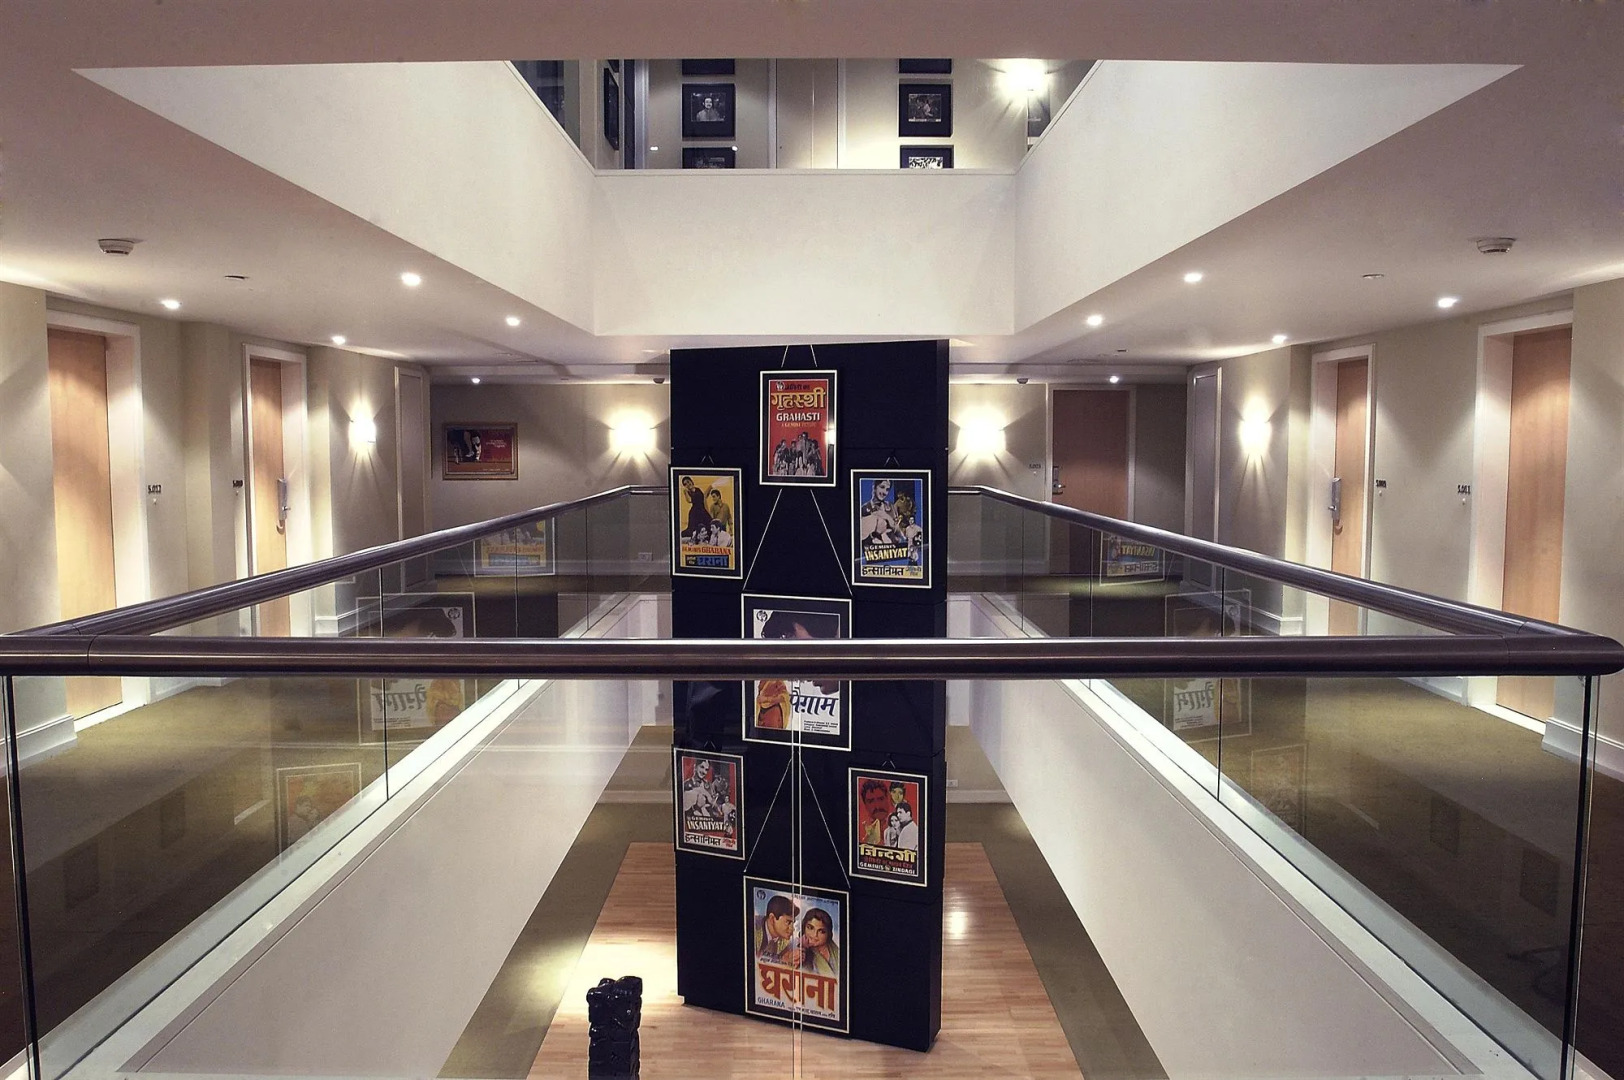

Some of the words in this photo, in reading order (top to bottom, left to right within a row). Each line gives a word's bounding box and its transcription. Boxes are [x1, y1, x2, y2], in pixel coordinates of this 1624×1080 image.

[770, 387, 826, 411] गृहस्थी
[776, 412, 820, 421] GRAHASTI
[864, 547, 908, 562] INSANIYAT
[687, 820, 724, 831] INSANIYAT
[892, 867, 915, 875] ZINDAGI
[758, 963, 838, 1012] घराना
[757, 997, 786, 1009] GHARANA
